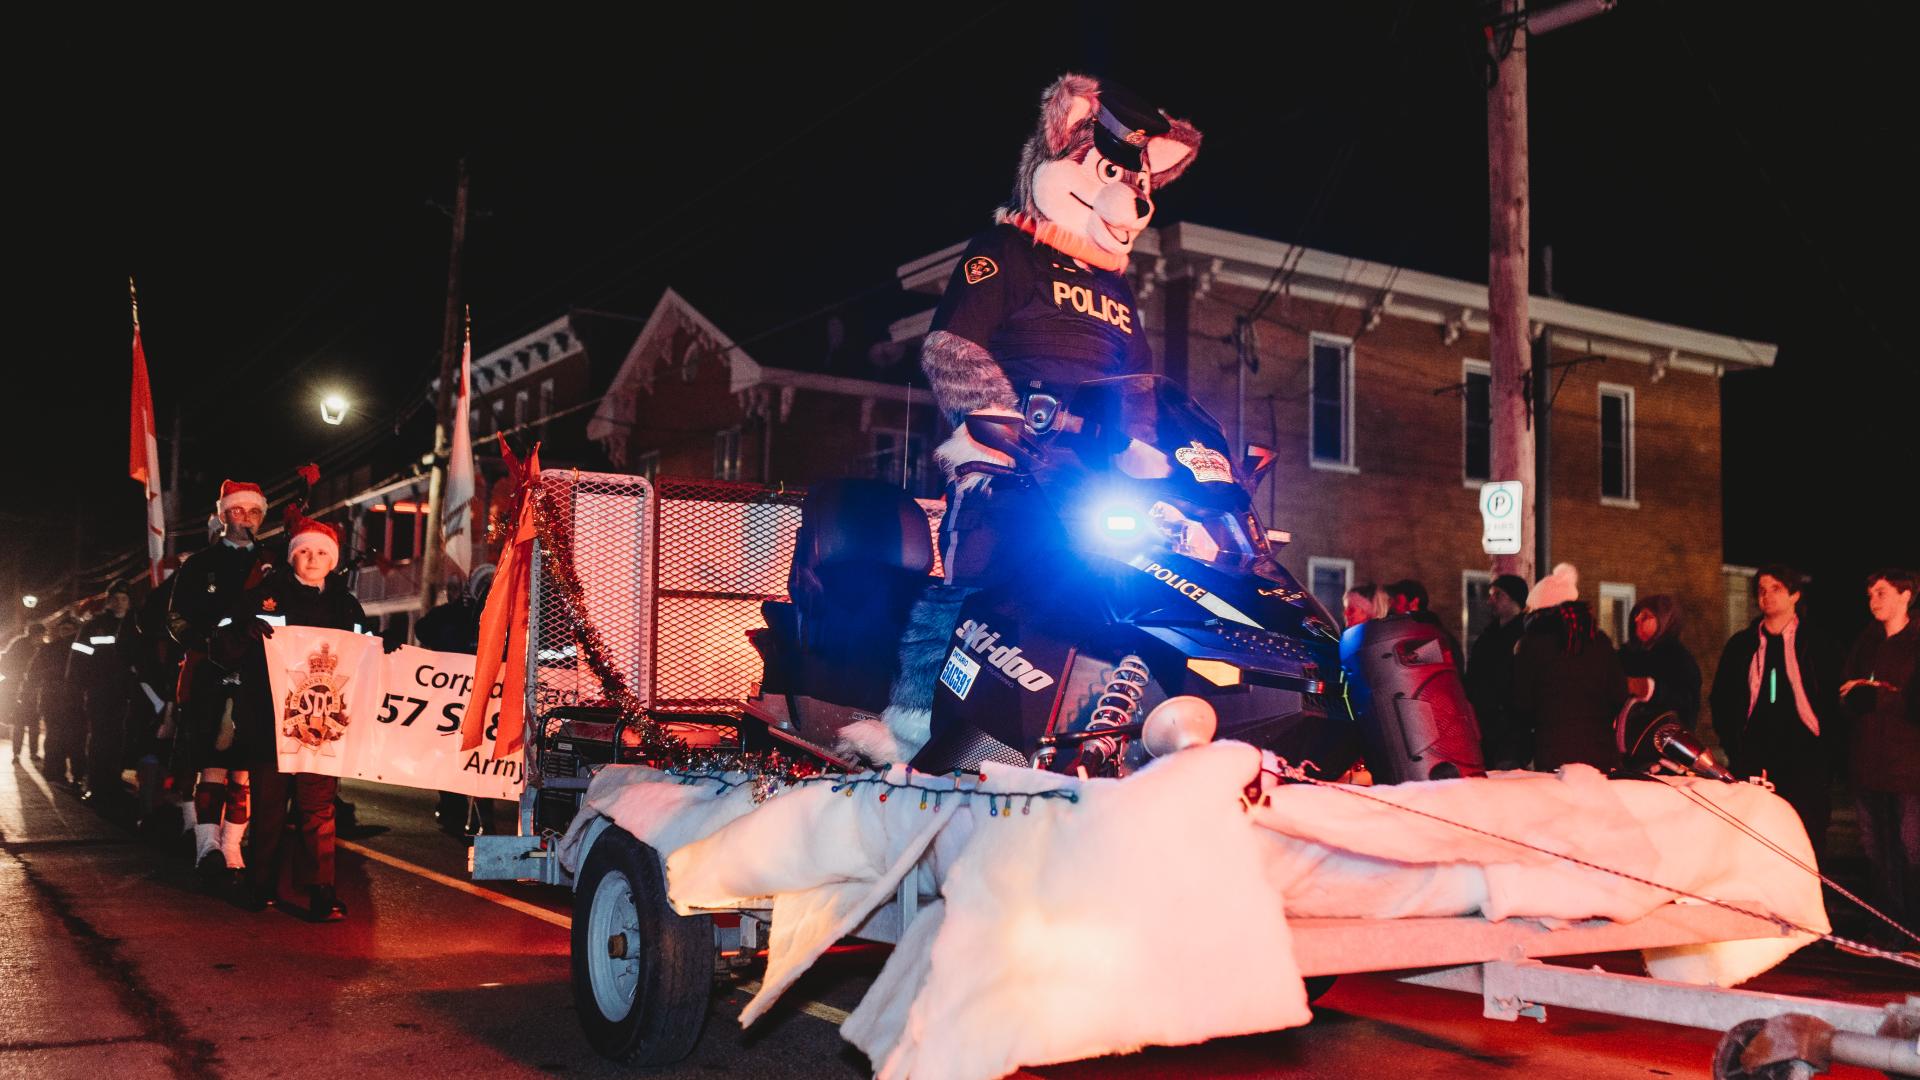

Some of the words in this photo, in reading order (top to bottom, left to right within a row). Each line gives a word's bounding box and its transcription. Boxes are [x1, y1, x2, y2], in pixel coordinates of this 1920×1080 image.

[1053, 281, 1132, 334] POLICE
[1146, 563, 1206, 601] POLICE
[956, 620, 1055, 692] ski-doo
[415, 665, 474, 697] Corp
[377, 692, 430, 727] 57
[463, 751, 524, 785] Army
